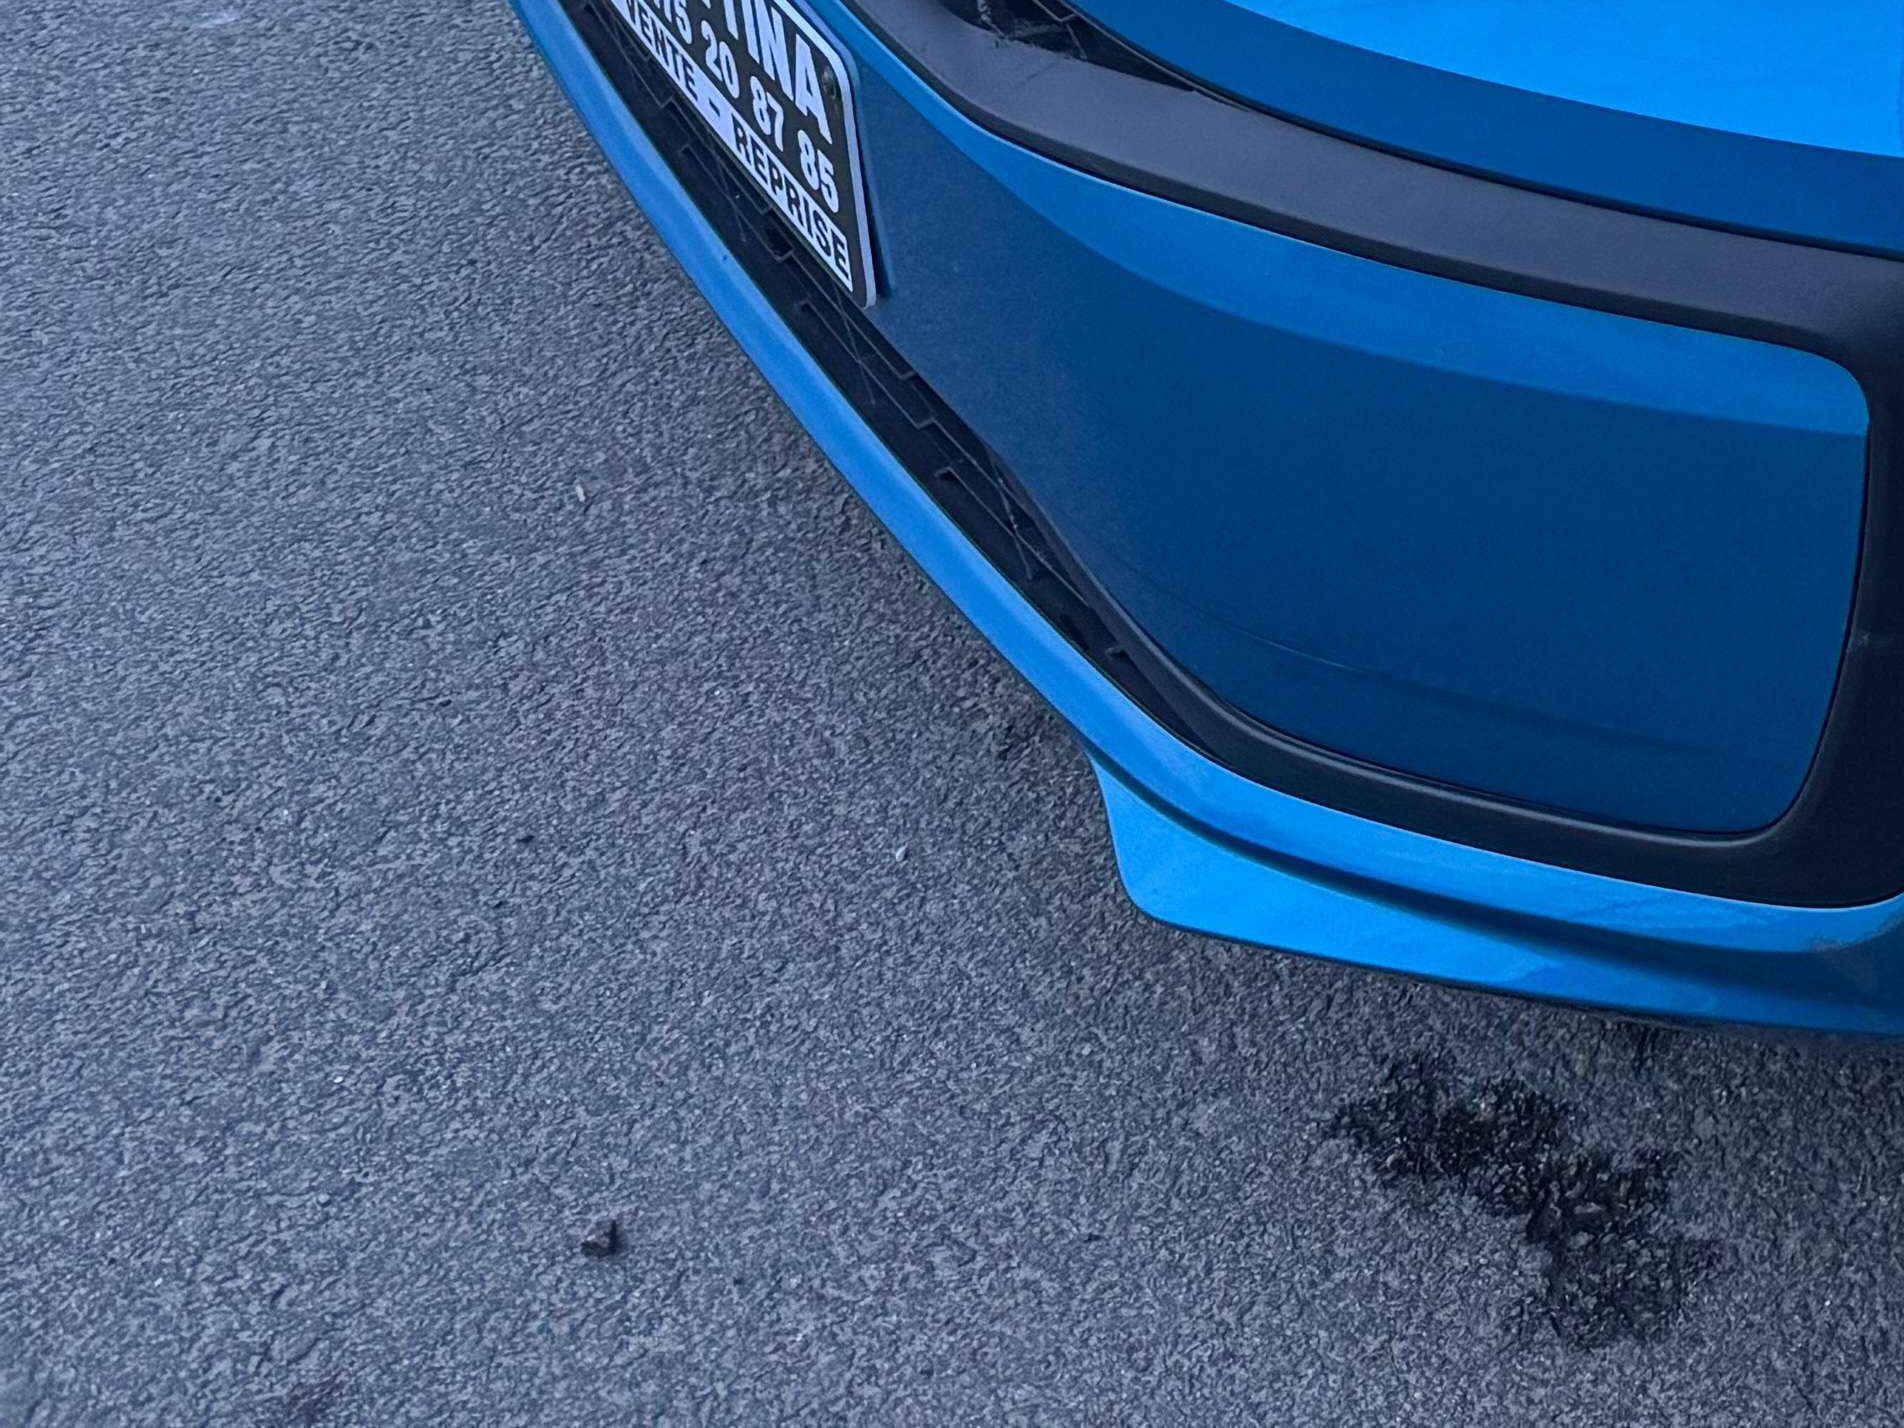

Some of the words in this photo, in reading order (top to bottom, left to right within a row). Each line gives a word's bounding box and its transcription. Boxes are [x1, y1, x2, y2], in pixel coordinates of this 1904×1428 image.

[700, 20, 740, 98] 20
[750, 75, 784, 152] 87
[797, 129, 839, 213] 85
[731, 112, 851, 280] REPRISE
